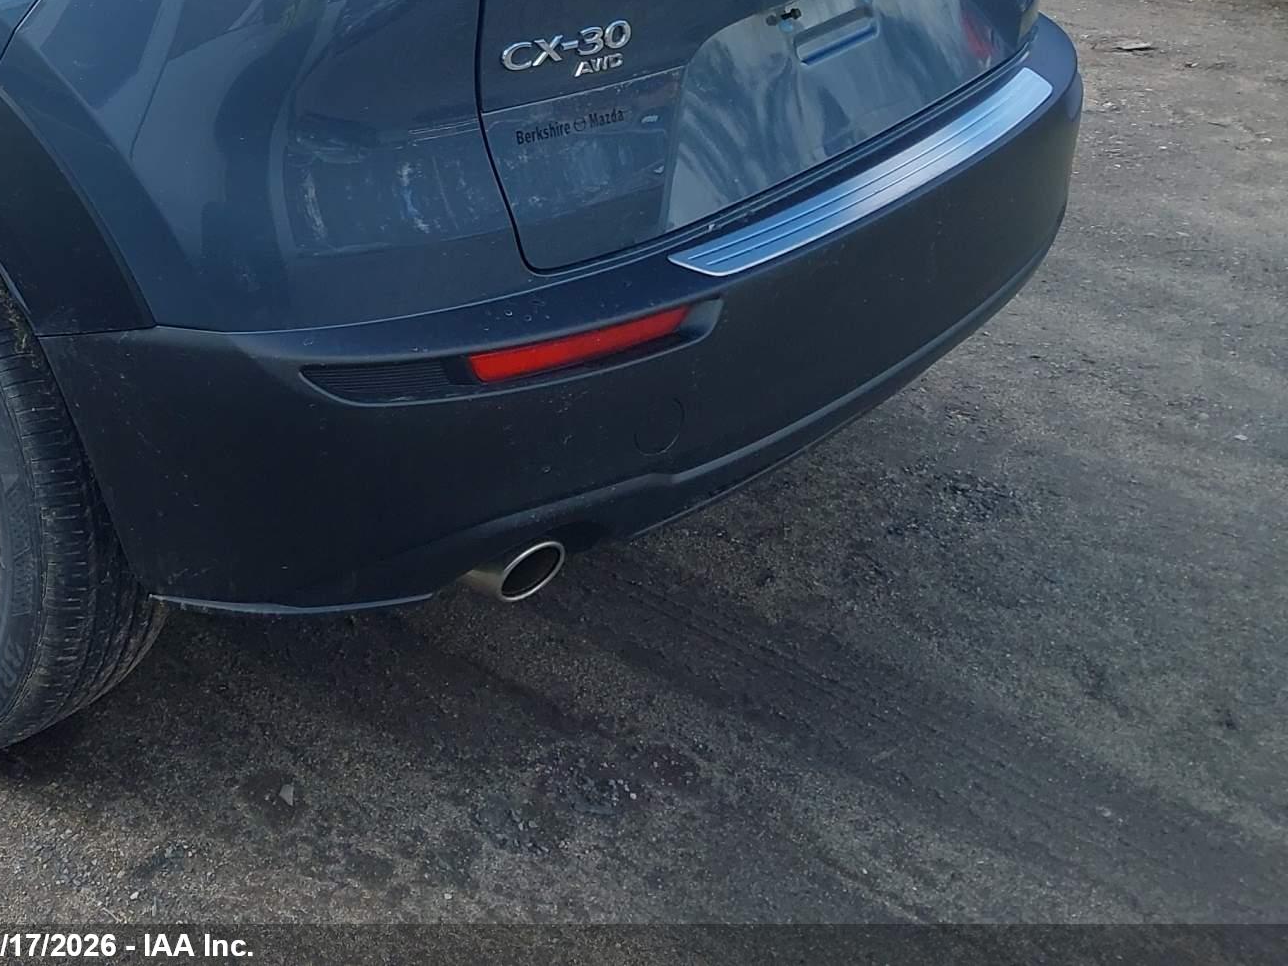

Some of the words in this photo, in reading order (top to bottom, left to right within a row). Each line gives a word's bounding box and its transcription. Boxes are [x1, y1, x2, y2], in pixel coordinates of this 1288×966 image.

[501, 19, 632, 71] CX-30
[574, 53, 624, 77] AWD
[515, 121, 571, 145] Berkshire
[588, 108, 624, 128] Mazda
